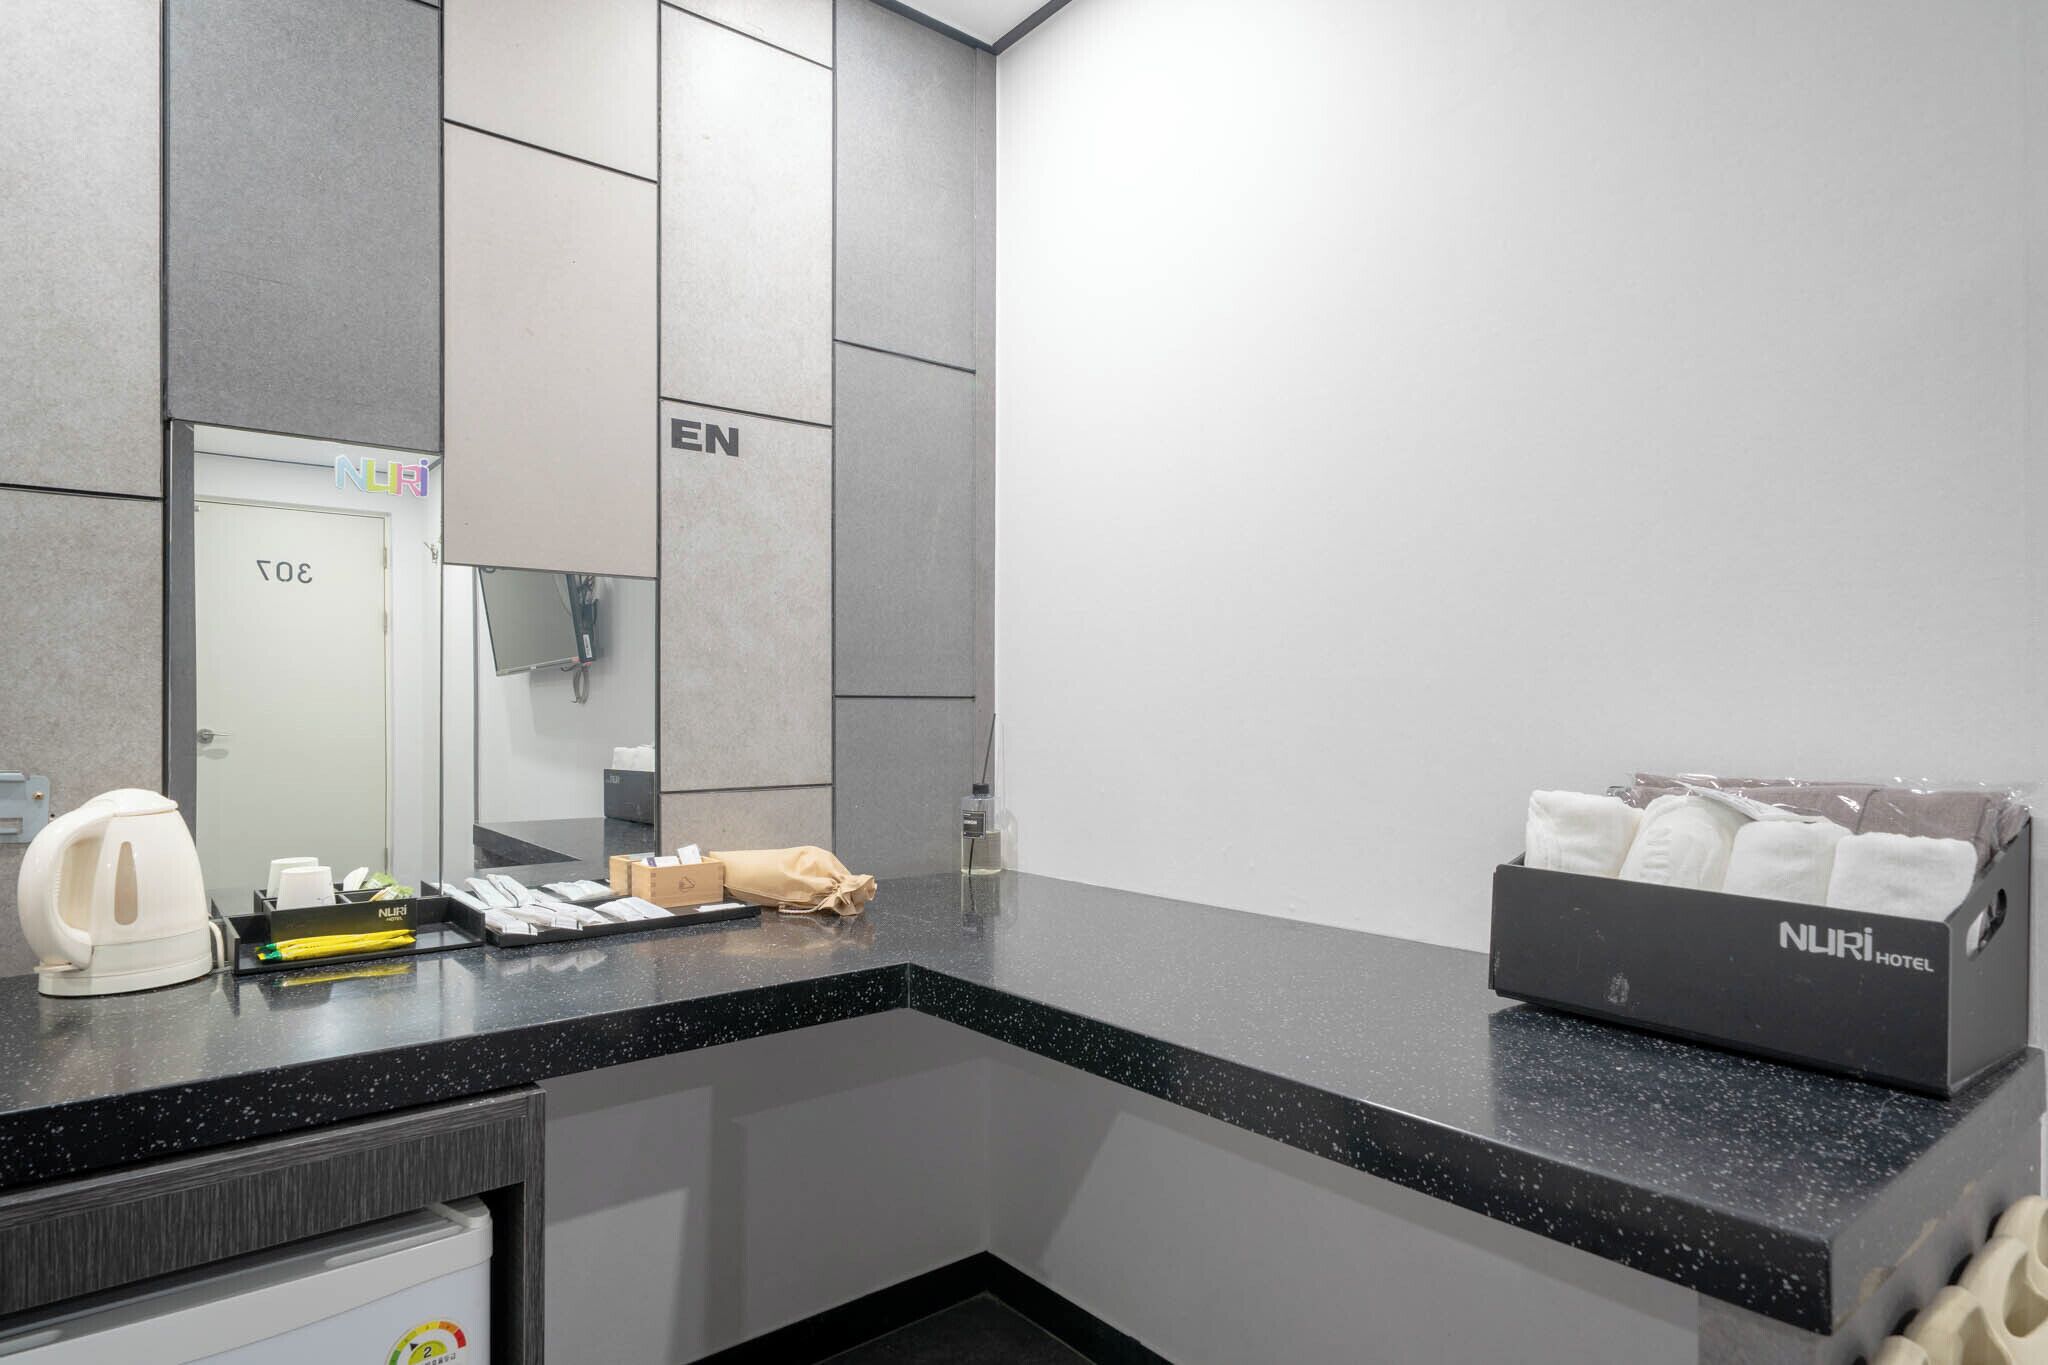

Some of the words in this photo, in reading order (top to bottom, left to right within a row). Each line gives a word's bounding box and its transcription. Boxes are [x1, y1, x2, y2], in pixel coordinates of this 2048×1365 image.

[671, 418, 739, 457] EN
[1875, 951, 1935, 972] HOTEL
[423, 1346, 433, 1359] 2
